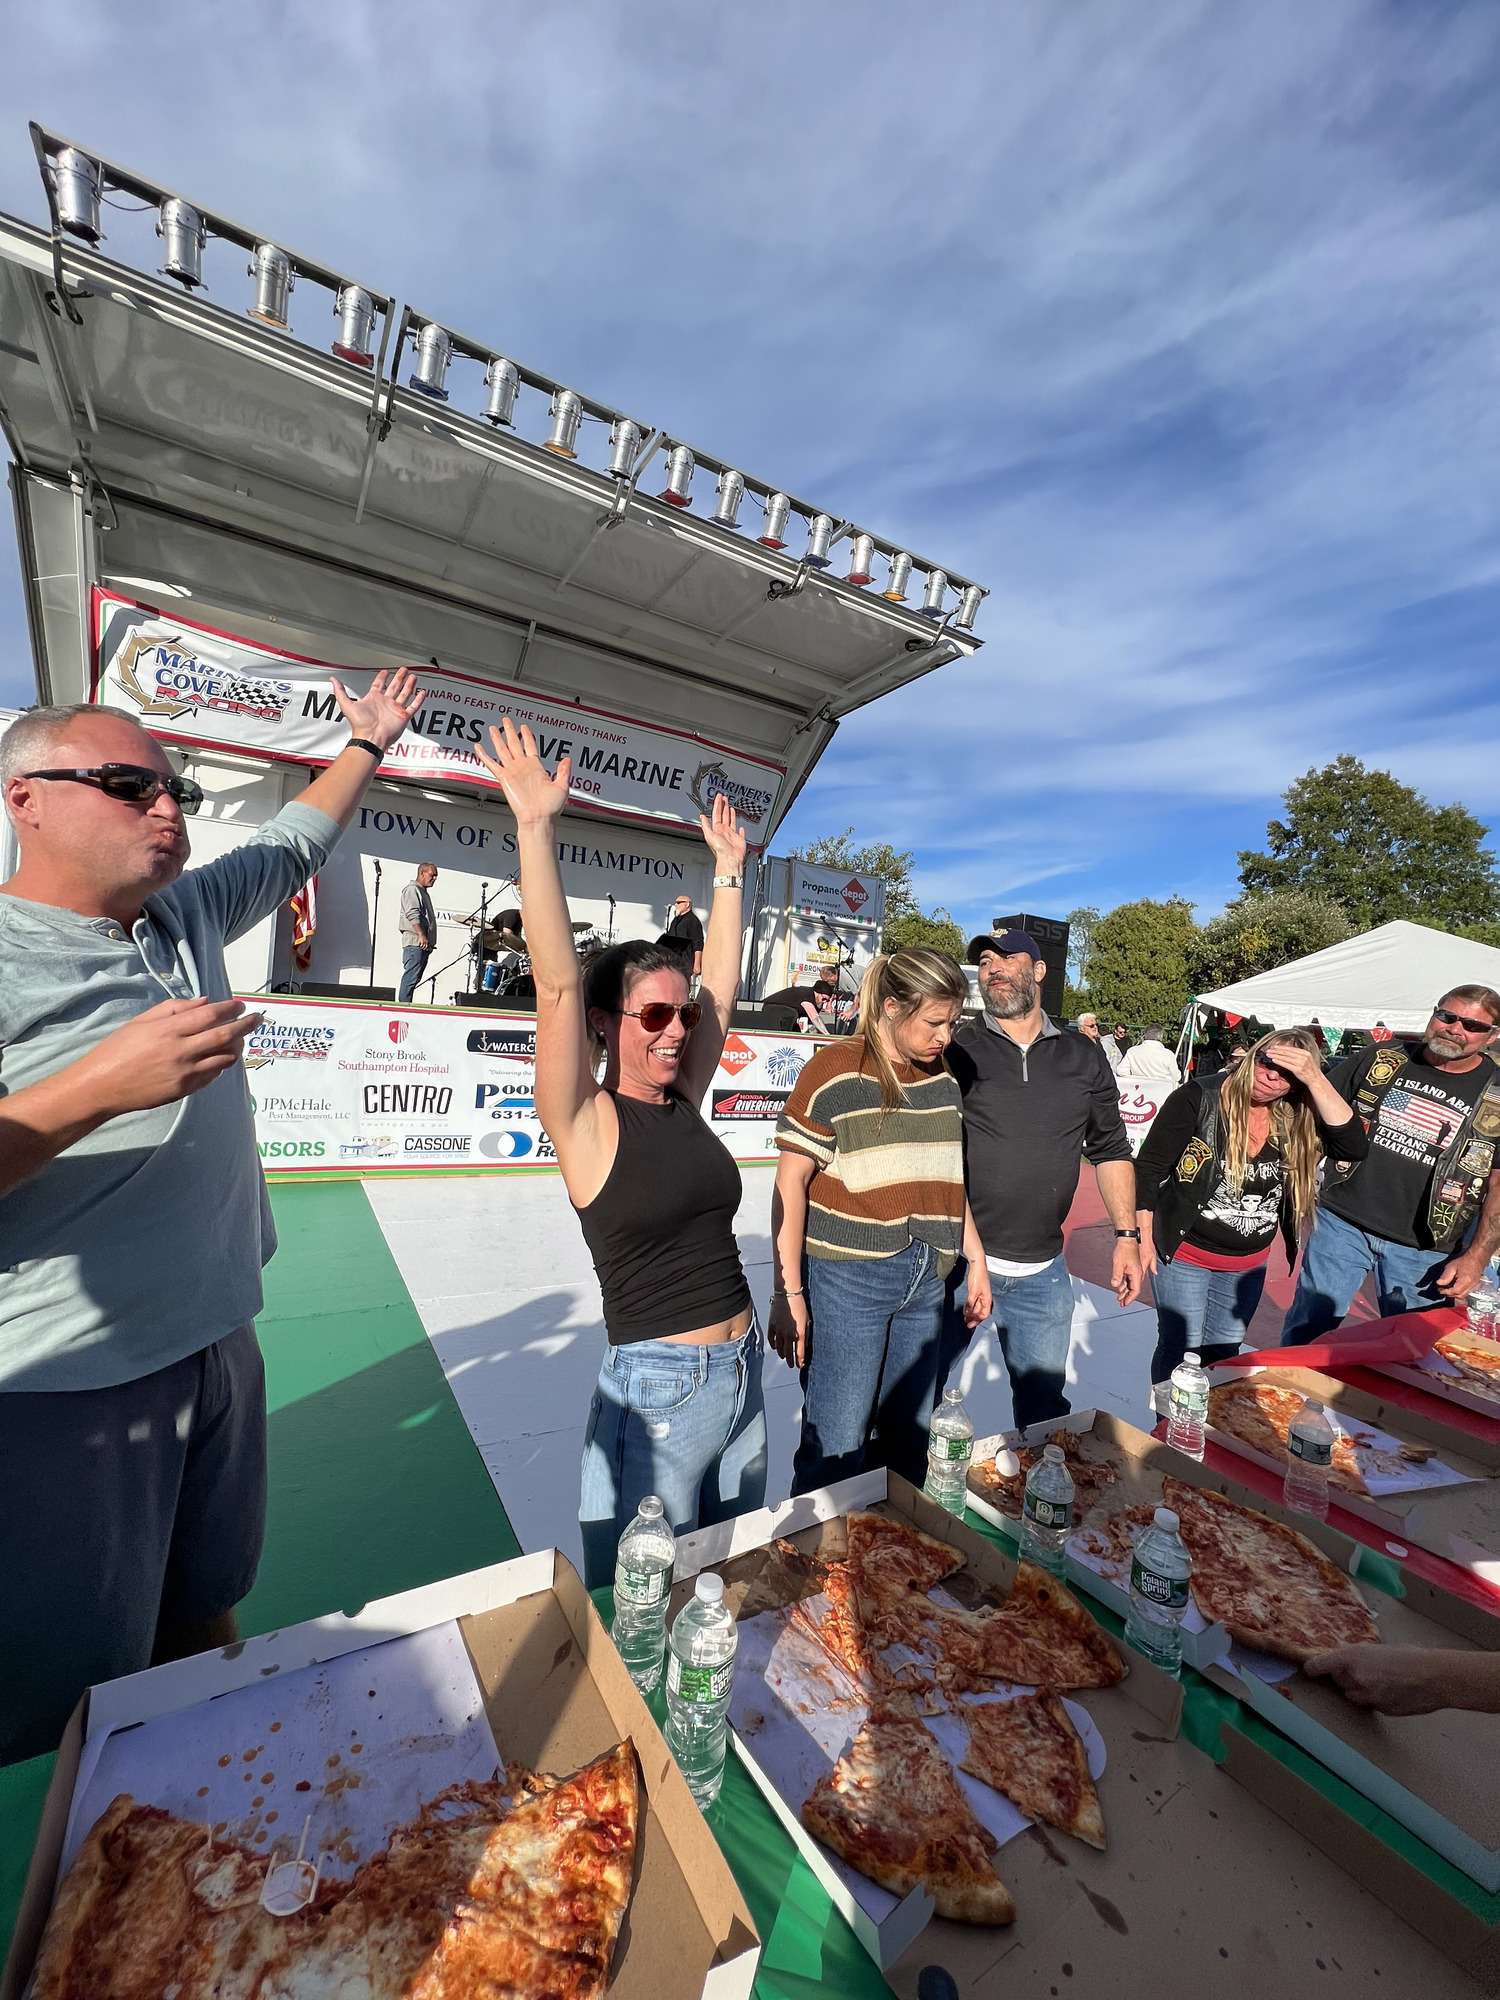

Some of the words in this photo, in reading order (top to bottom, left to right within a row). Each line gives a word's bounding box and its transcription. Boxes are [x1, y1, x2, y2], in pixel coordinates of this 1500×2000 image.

[155, 647, 293, 692] MARINER'S
[155, 668, 222, 697] COVE
[155, 685, 282, 722] RACING
[464, 696, 497, 712] FEAST
[498, 704, 513, 715] OF
[515, 708, 534, 721] THE
[536, 714, 590, 736] HAMPTONS
[592, 728, 628, 745] THANKS
[578, 745, 685, 790] MARINE
[707, 772, 773, 804] MARINER'S
[358, 806, 446, 842] TOWN
[456, 825, 493, 849] OF
[502, 832, 685, 880] STHAMPTON
[801, 880, 840, 896] Propane
[841, 887, 867, 901] depot
[250, 1023, 335, 1039] MARINER'S
[248, 1037, 291, 1049] COVE
[491, 1042, 536, 1053] WATERC
[247, 1048, 329, 1060] RACING
[365, 1048, 395, 1061] Stony
[396, 1049, 427, 1061] Brook
[721, 1050, 754, 1063] epot
[337, 1060, 407, 1074] Southampton
[409, 1062, 450, 1075] Hospital
[1404, 1079, 1447, 1099] ISLAND
[363, 1084, 453, 1115] CENTRO
[734, 1099, 785, 1112] RIVERHEAD
[285, 1112, 333, 1120] Management,
[404, 1137, 472, 1151] CASSONE
[1141, 1571, 1171, 1590] Poland
[1141, 1581, 1171, 1598] Spring
